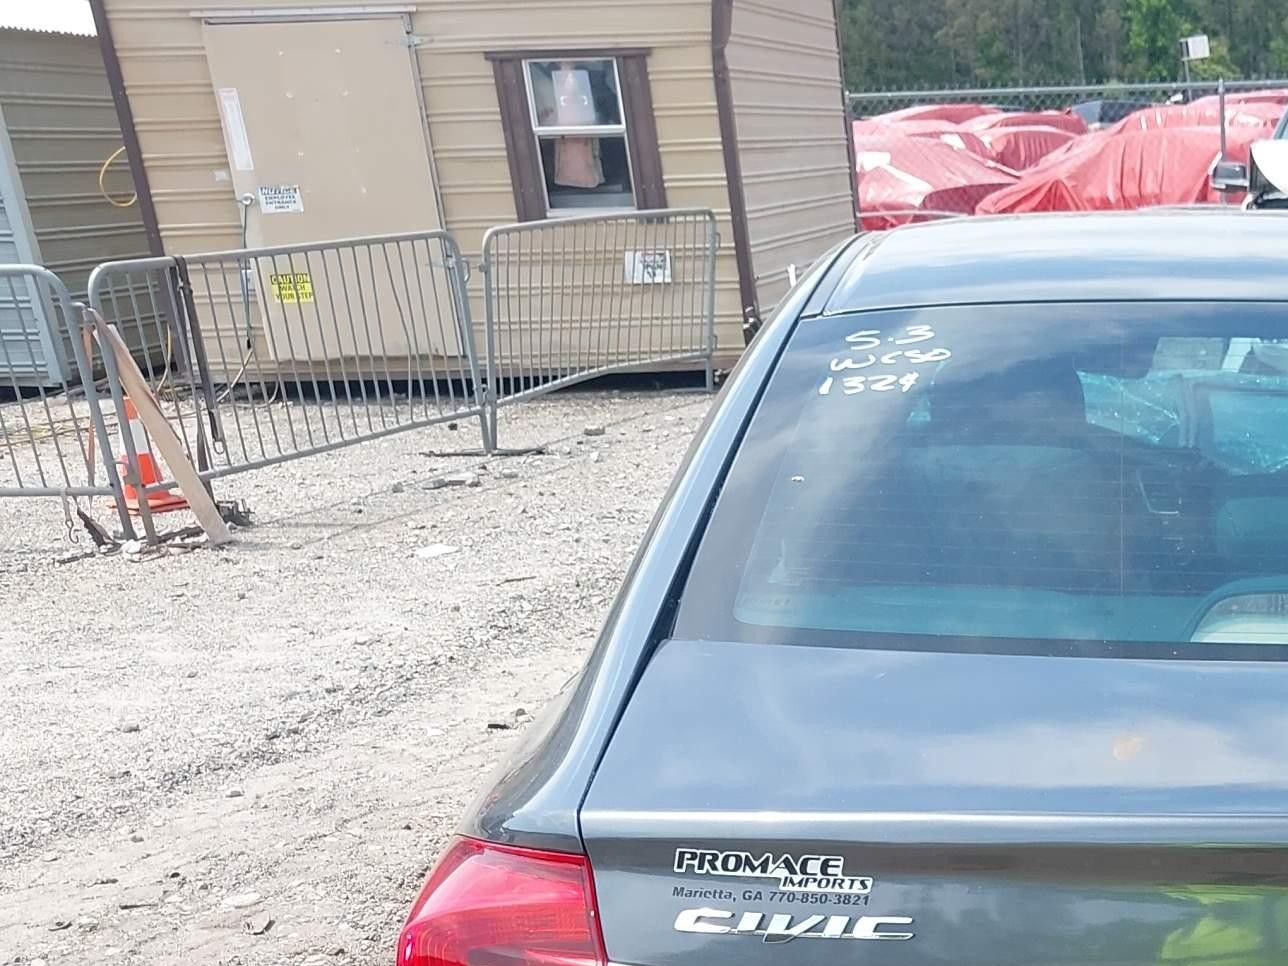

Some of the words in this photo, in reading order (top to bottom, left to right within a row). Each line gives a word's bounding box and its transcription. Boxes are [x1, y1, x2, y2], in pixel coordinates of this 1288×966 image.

[674, 849, 843, 878] PROMACE
[781, 876, 872, 891] IMPORTS
[672, 886, 737, 902] Marietta,
[742, 890, 763, 902] GA
[769, 891, 869, 906] 770-850-3821
[674, 907, 914, 944] CIVIC
